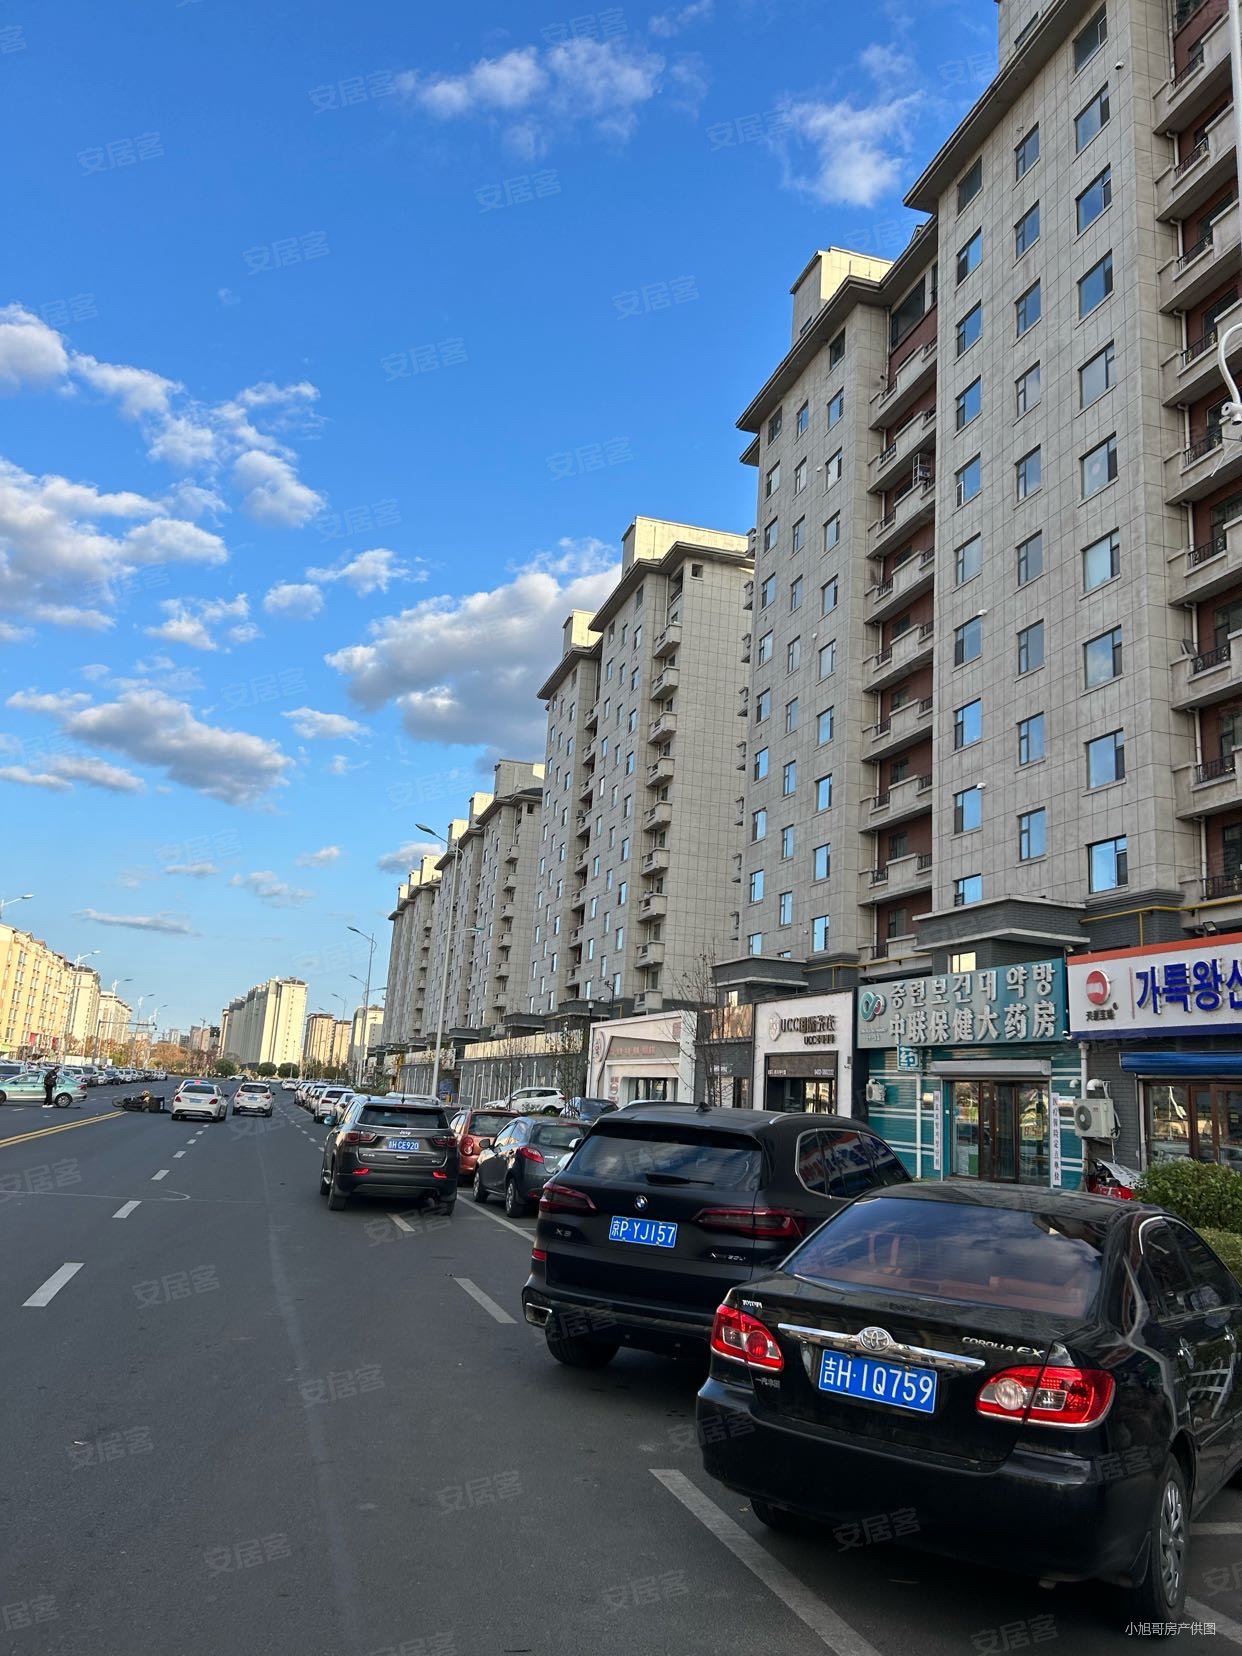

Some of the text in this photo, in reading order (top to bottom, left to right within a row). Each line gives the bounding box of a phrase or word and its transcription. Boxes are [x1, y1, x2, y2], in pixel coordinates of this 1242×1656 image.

[889, 1000, 1057, 1044] 中联保健大药房
[899, 1046, 919, 1066] 药
[961, 1336, 1045, 1358] COROLLA EX
